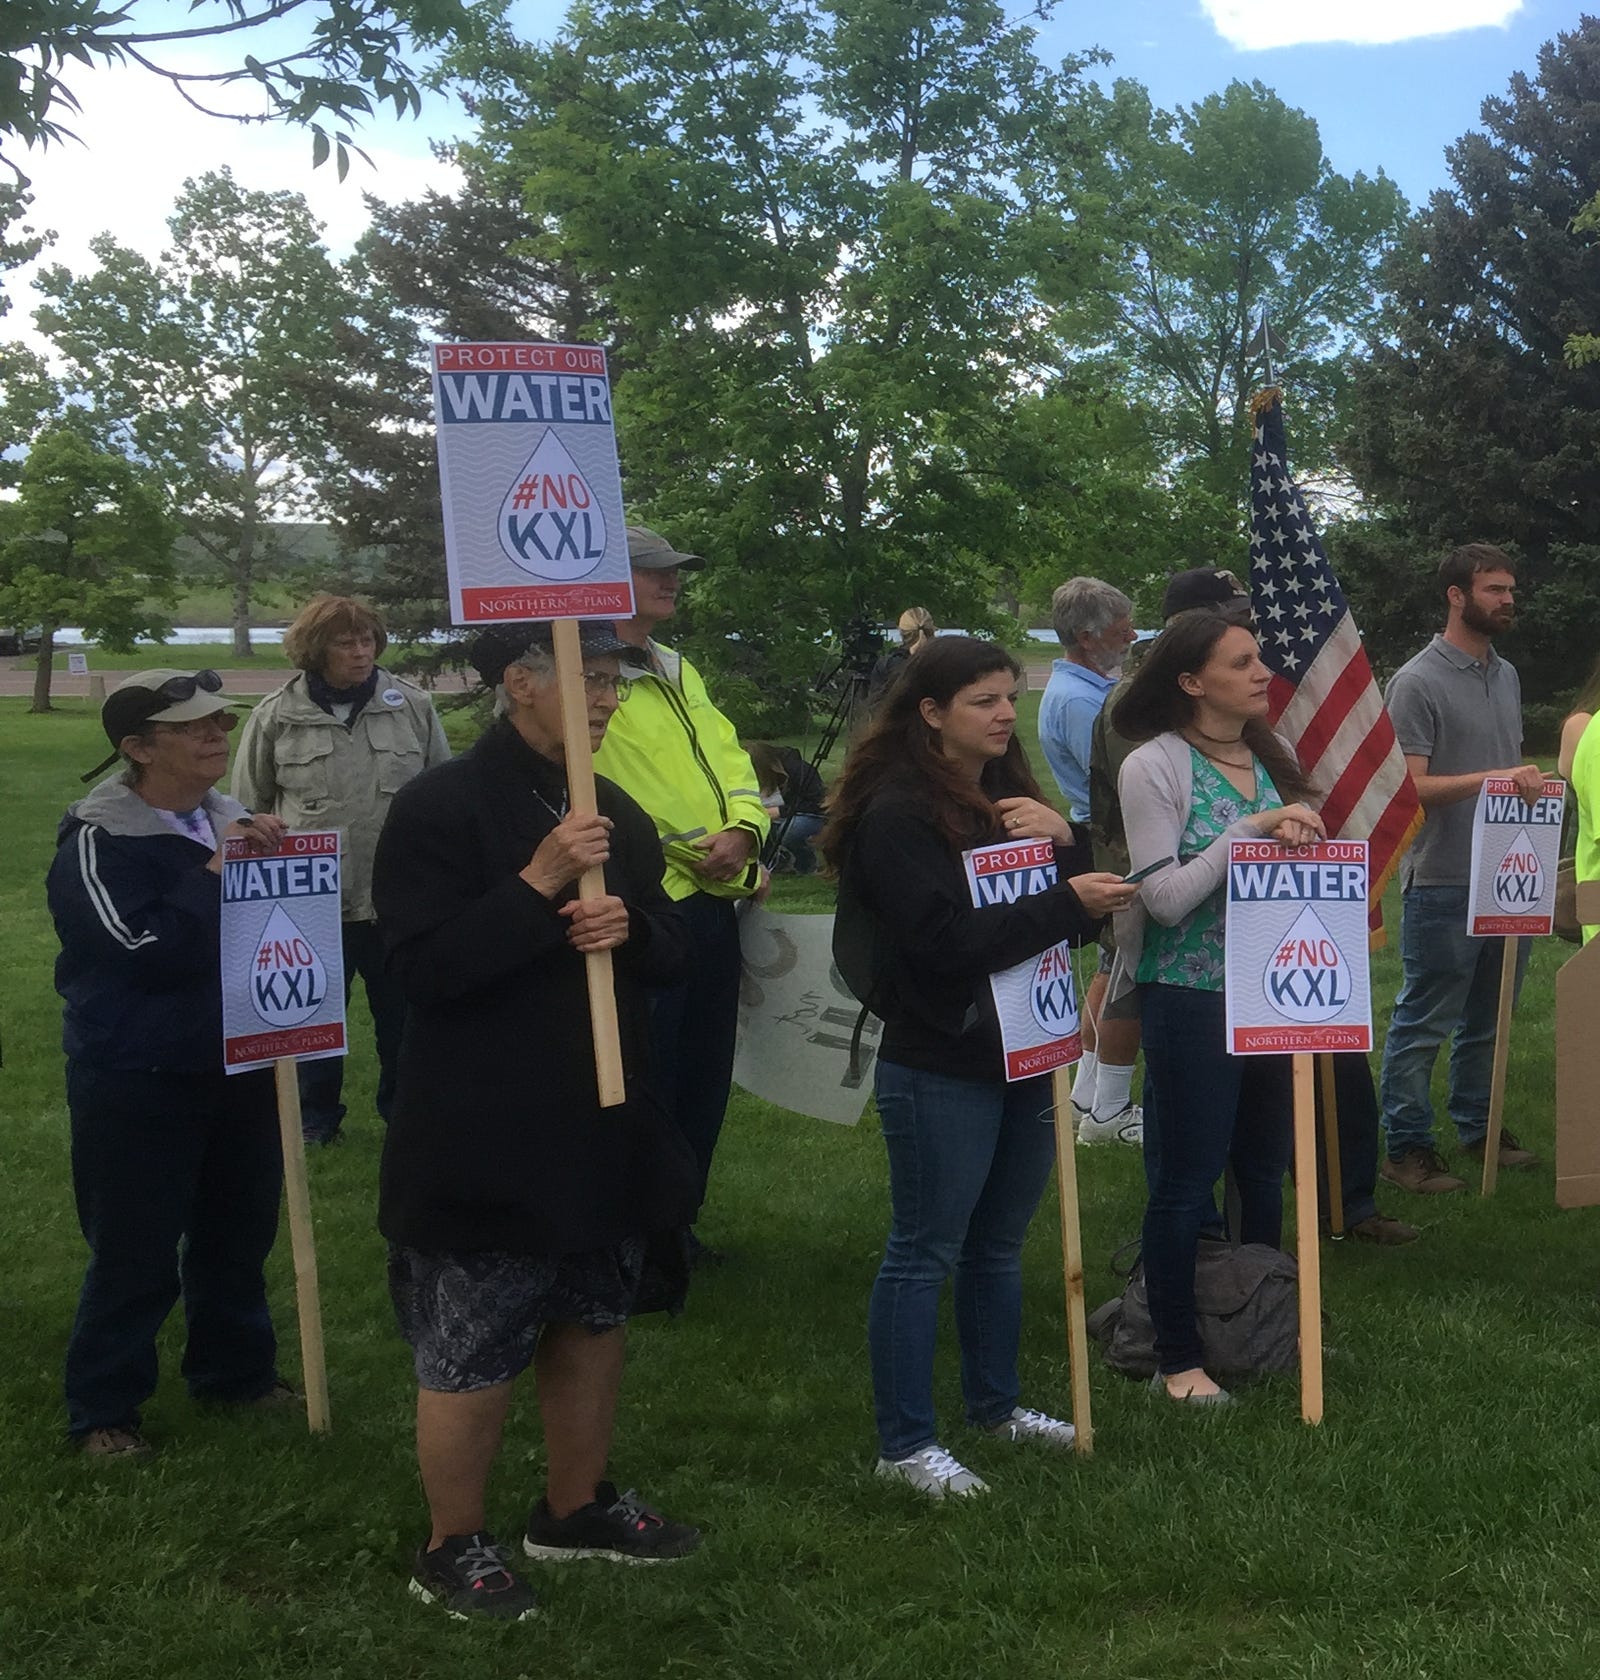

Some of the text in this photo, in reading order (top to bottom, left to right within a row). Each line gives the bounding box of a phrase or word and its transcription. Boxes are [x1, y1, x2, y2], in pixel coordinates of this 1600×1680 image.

[439, 349, 602, 369] PROTECT OUR
[441, 374, 611, 421] WATER
[512, 474, 590, 509] #NO
[508, 512, 602, 560] KXL
[479, 597, 568, 614] NORTHERN
[584, 594, 623, 608] PLAINS
[1487, 782, 1519, 792] PROT
[1487, 796, 1562, 823] WATER
[294, 836, 335, 851] OUR
[975, 844, 1053, 871] PROTEC
[1232, 845, 1364, 859] PROTECT OUR
[1500, 853, 1538, 874] #NO
[225, 857, 338, 900] WATER
[978, 865, 1058, 905] WAT
[1232, 864, 1365, 899] WATER
[1496, 874, 1540, 903] KXL
[257, 938, 313, 971] #NO
[1275, 939, 1338, 967] #NO
[256, 968, 322, 1012] KXL
[1270, 969, 1346, 1006] KXL
[1245, 1034, 1360, 1048] NORTHERN PLAINS
